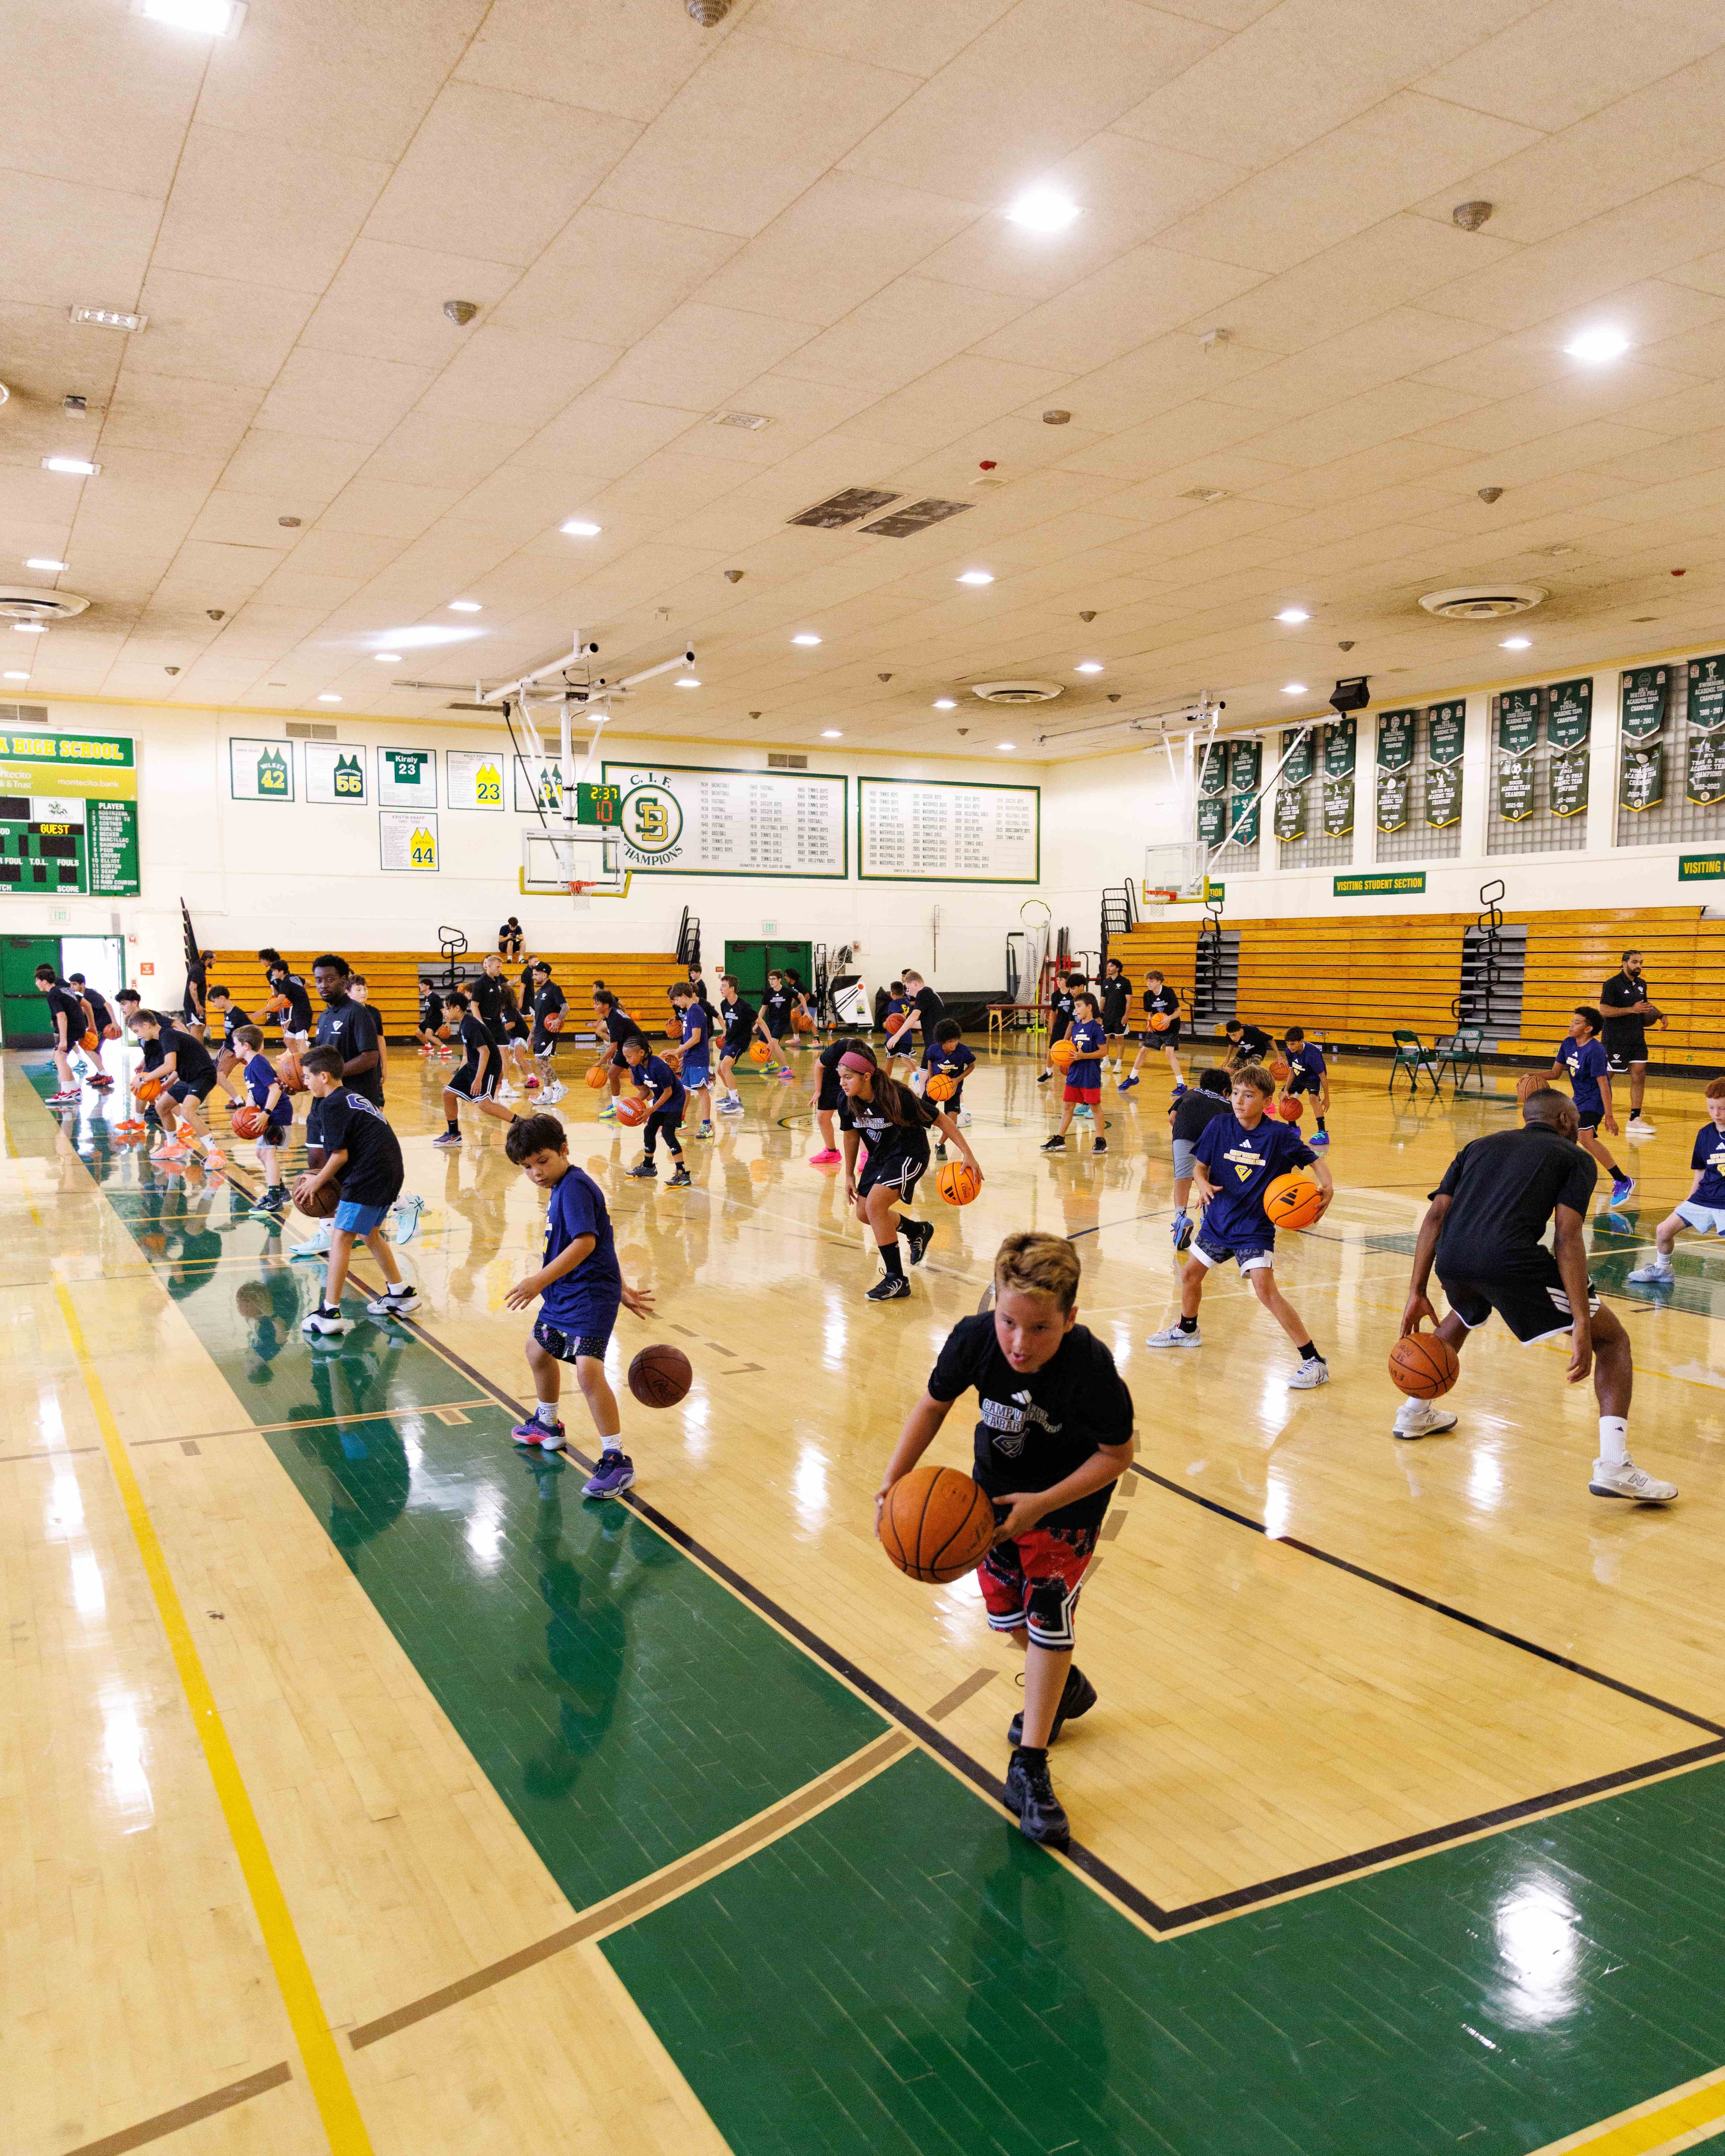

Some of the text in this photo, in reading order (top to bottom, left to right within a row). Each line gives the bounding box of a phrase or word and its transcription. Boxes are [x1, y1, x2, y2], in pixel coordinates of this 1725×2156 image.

[13, 738, 56, 755] HIGH
[60, 740, 124, 760] SCHOOL
[395, 755, 418, 764] Kiraly
[398, 764, 416, 775] 23
[261, 770, 285, 789] 42
[336, 775, 362, 792] 55
[477, 782, 500, 800] 23
[590, 786, 617, 800] 2:37
[98, 802, 124, 810] PLAYER
[597, 800, 613, 822] 10
[40, 823, 70, 835] GUEST
[5, 857, 80, 867] FOUL T.O.L. FOULS
[412, 848, 434, 863] 44
[1683, 860, 1721, 874] VISITING
[1337, 878, 1423, 892] VISITING STUDENT SECTION
[1459, 1030, 1479, 1038] DONS
[982, 1398, 1014, 1419] CAMP
[1628, 1472, 1649, 1487] N
